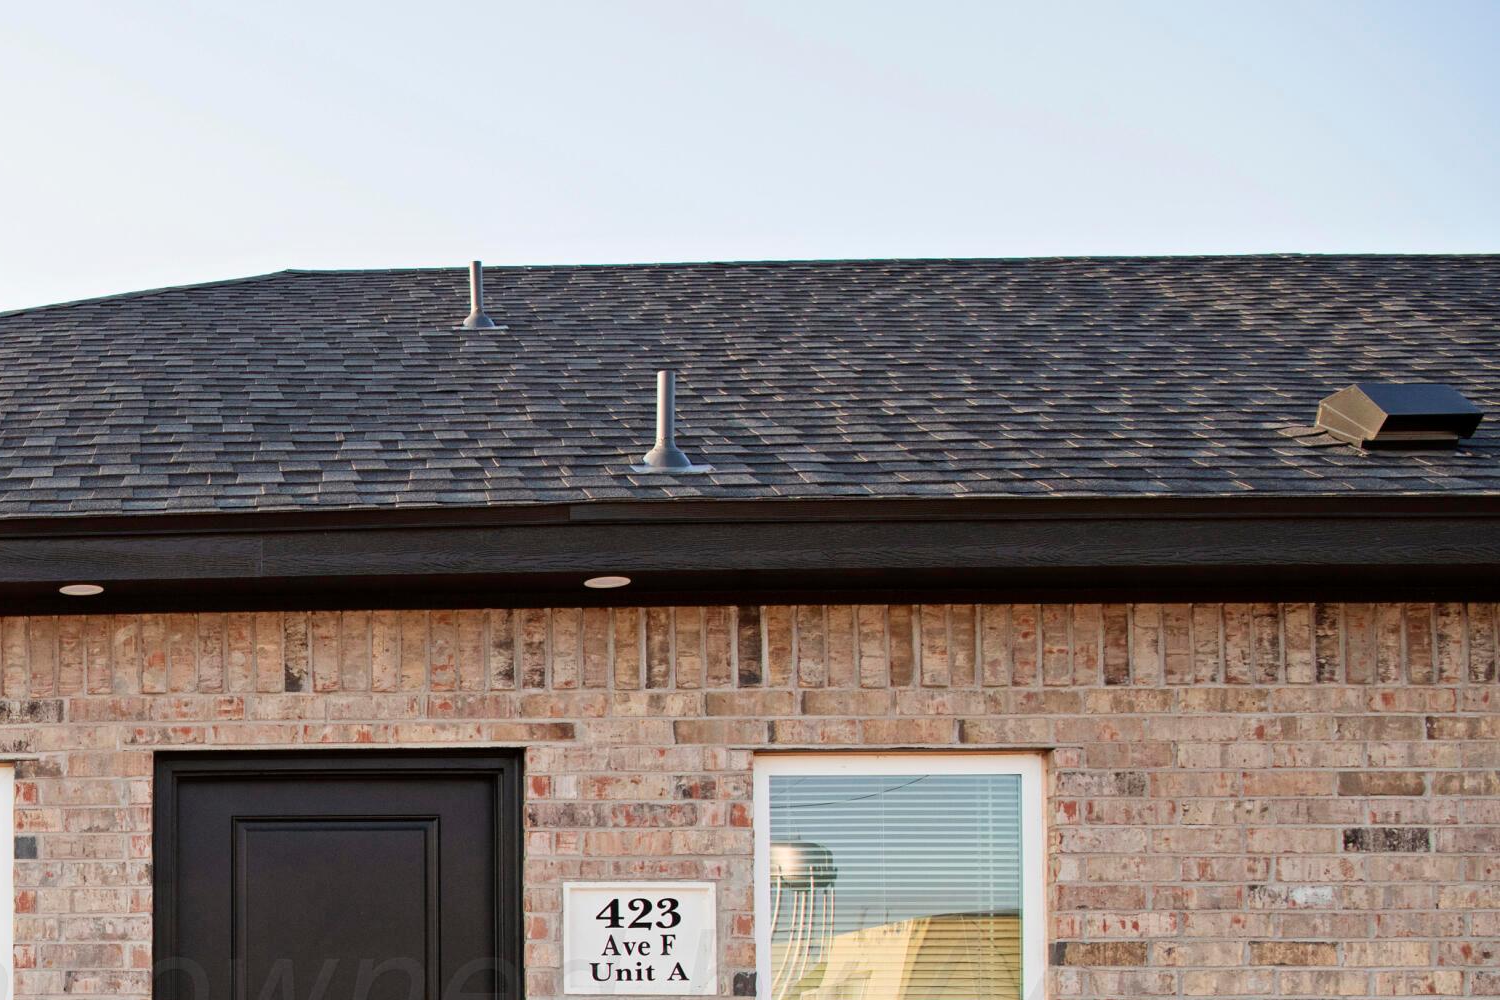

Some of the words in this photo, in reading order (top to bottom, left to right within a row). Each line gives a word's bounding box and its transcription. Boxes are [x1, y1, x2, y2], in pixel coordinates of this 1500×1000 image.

[596, 898, 682, 930] 423
[601, 934, 650, 956] Ave
[660, 934, 677, 956] F
[589, 962, 656, 982] Unit
[667, 962, 690, 981] A
